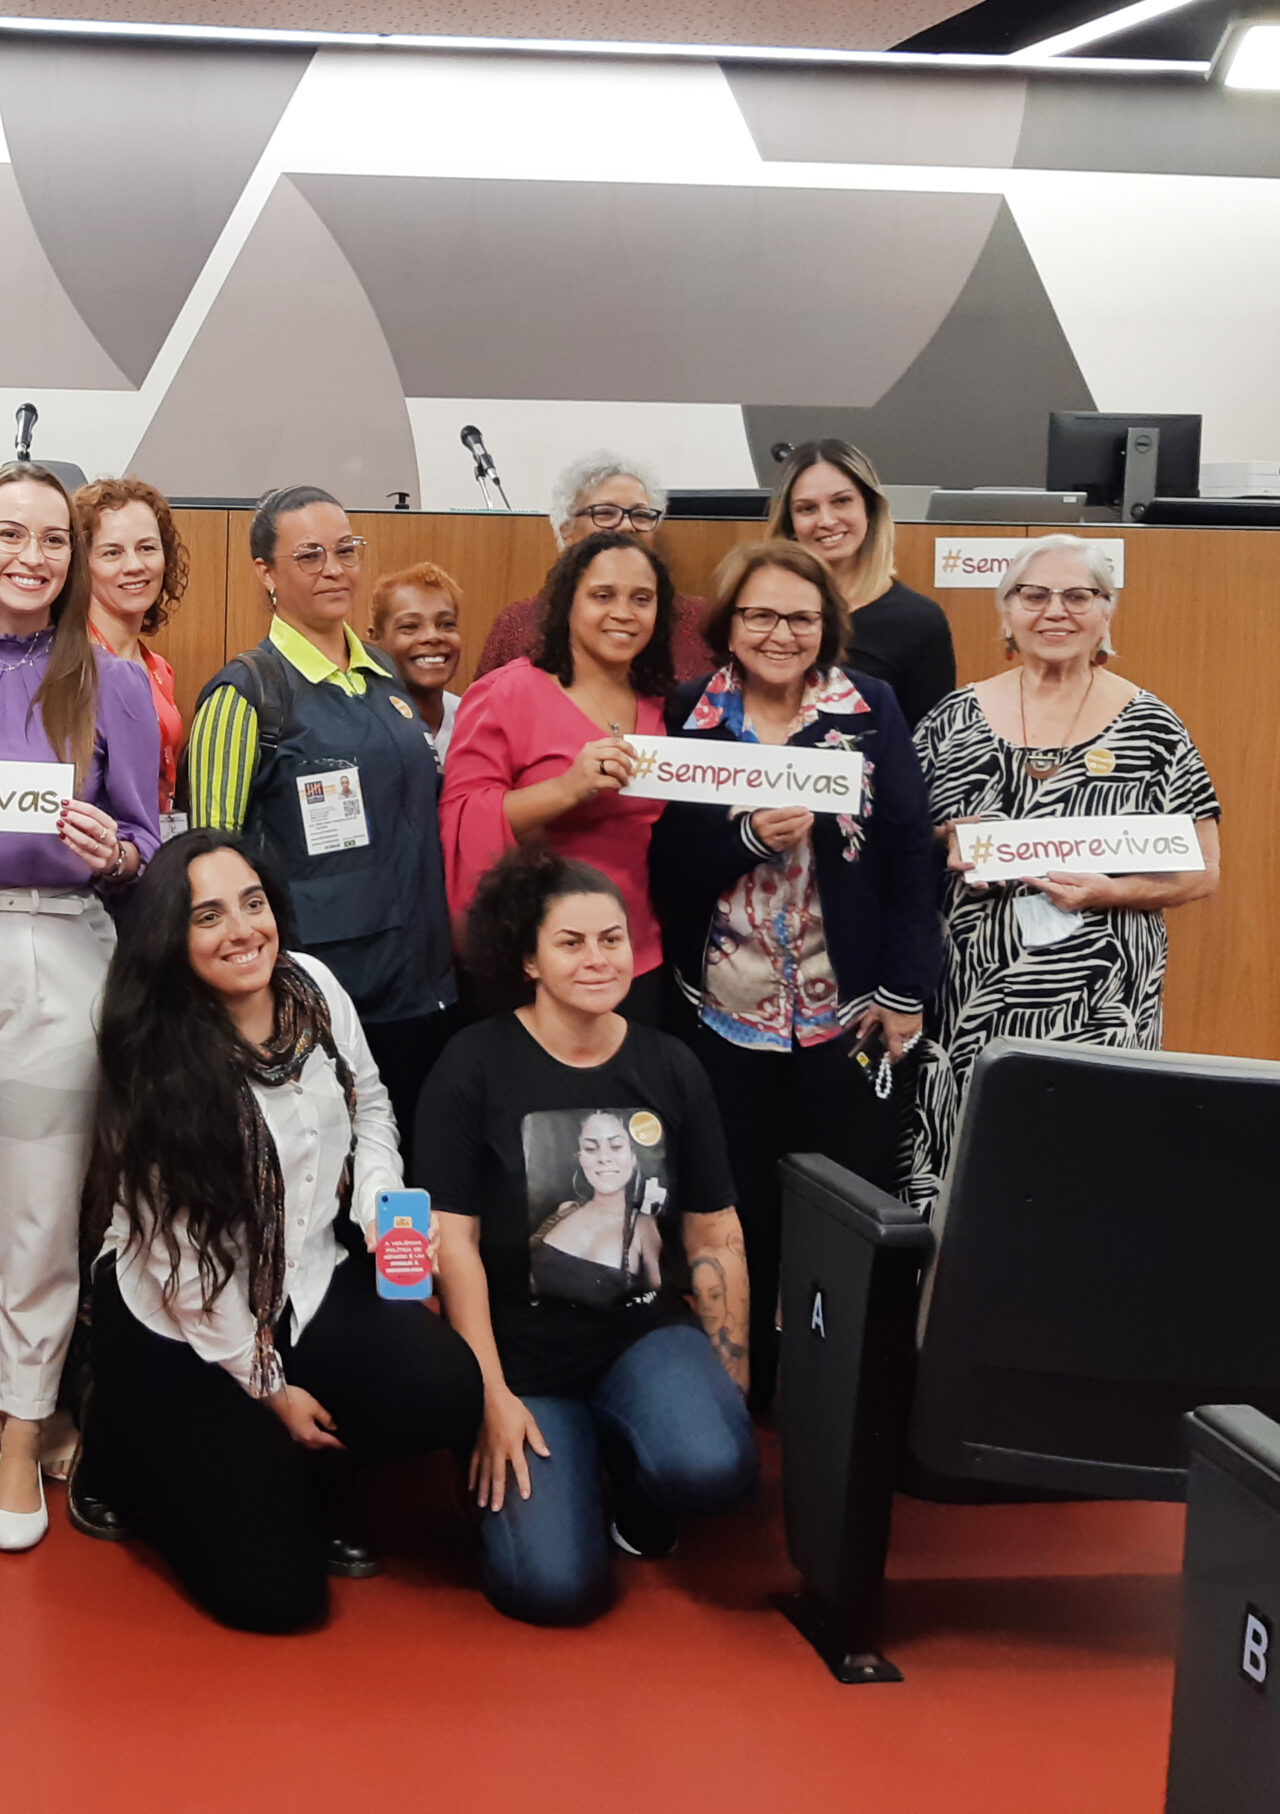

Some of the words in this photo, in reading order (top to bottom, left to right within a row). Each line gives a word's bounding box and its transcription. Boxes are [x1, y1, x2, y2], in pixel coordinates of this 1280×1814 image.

[629, 749, 850, 796] #semprevivas
[969, 830, 1190, 864] #semprevivas
[811, 1291, 826, 1338] A
[1243, 1613, 1268, 1683] B
